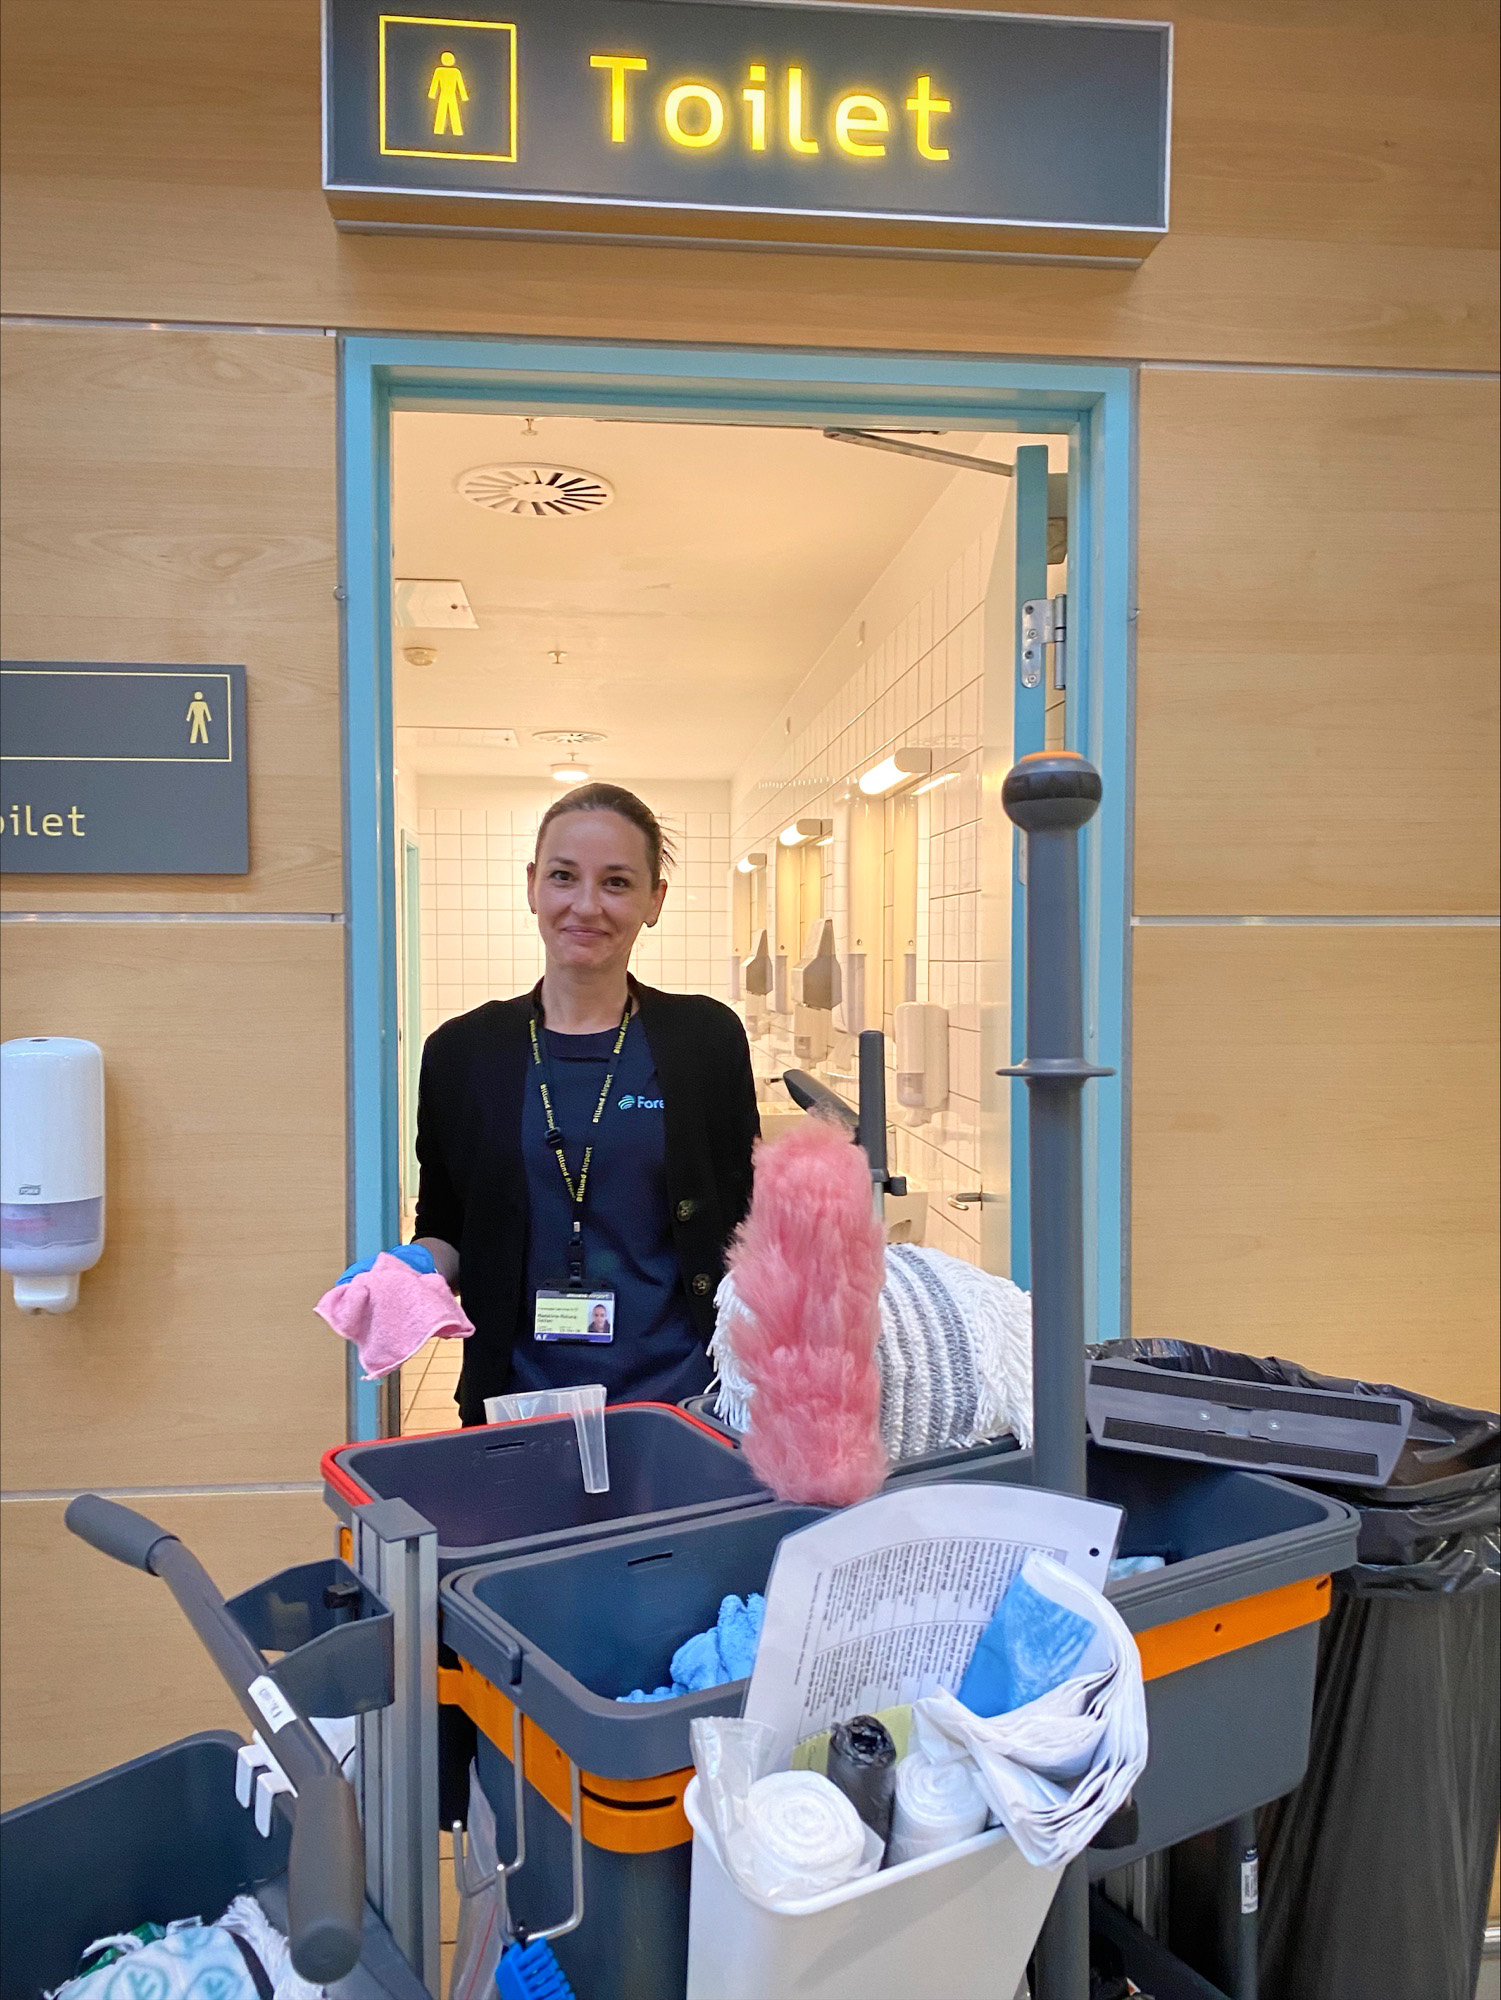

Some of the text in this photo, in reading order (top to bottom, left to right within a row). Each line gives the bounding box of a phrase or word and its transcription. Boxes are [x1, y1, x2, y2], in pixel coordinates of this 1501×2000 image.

[589, 54, 951, 161] Toilet
[0, 804, 86, 837] ilet
[546, 1109, 555, 1129] Airpor
[592, 1074, 614, 1124] Billund Airport
[555, 1149, 570, 1177] Billund
[576, 1147, 593, 1202] Billund Airport
